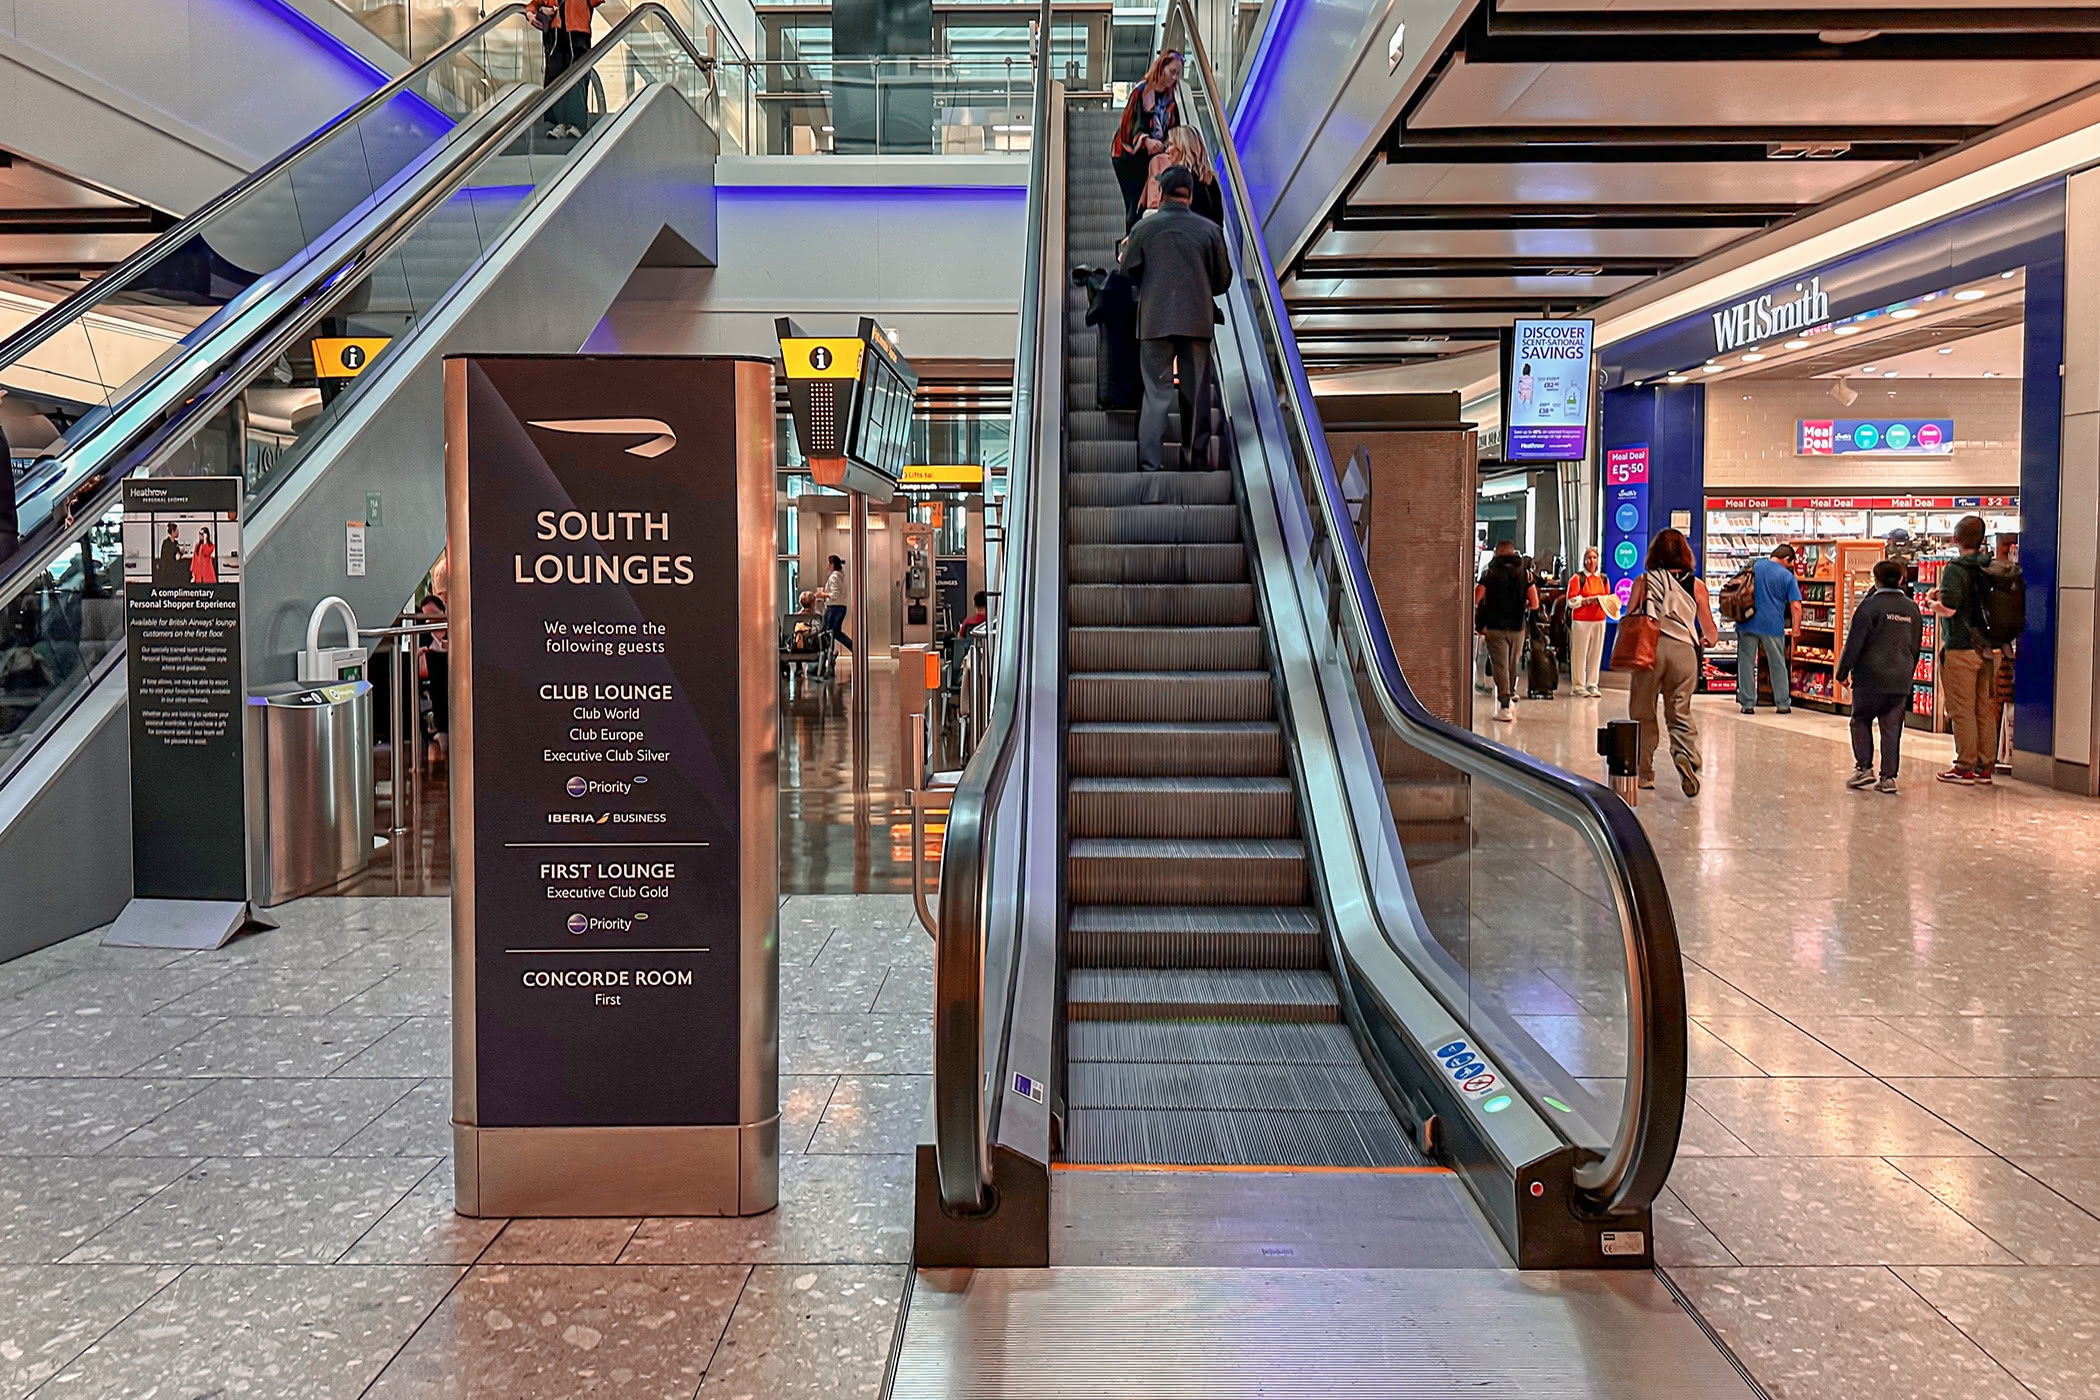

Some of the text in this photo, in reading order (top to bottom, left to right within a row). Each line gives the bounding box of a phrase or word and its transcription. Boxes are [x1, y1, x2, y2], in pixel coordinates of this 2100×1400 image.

[1712, 276, 1829, 353] WHSmith
[1524, 327, 1585, 339] DISCOVER
[1522, 346, 1584, 359] SAVINGS
[1804, 426, 1833, 438] Meal
[1804, 437, 1833, 449] Deal
[1612, 451, 1645, 462] Meal Deal
[130, 488, 168, 497] Heathrow
[1726, 499, 1768, 508] Meal Deal
[1811, 499, 1853, 508] Meal Deal
[1892, 499, 1934, 507] Meal Deal
[536, 511, 669, 541] SOUTH
[515, 554, 695, 585] LOUNGES
[151, 589, 214, 599] A complimentary
[130, 600, 236, 611] Personal Shopper Experience
[130, 618, 157, 626] Available
[159, 618, 167, 627] for
[169, 618, 188, 626] British
[215, 618, 236, 629] lounge
[544, 620, 666, 635] We welcome the
[196, 630, 208, 638] first
[546, 639, 665, 656] following guests
[540, 685, 673, 700] CLUB LOUNGE
[573, 707, 640, 720] Club World
[569, 728, 644, 744] Club Europe
[544, 749, 670, 762] Executive Club Silver
[589, 780, 632, 795] Priority
[548, 813, 667, 824] IBERIA BUSINESS
[540, 864, 676, 880] FIRST LOUNGE
[547, 886, 669, 899] Executive Club Gold
[590, 918, 632, 932] Priority
[523, 971, 693, 987] CONCORDE ROOM
[595, 994, 621, 1006] First
